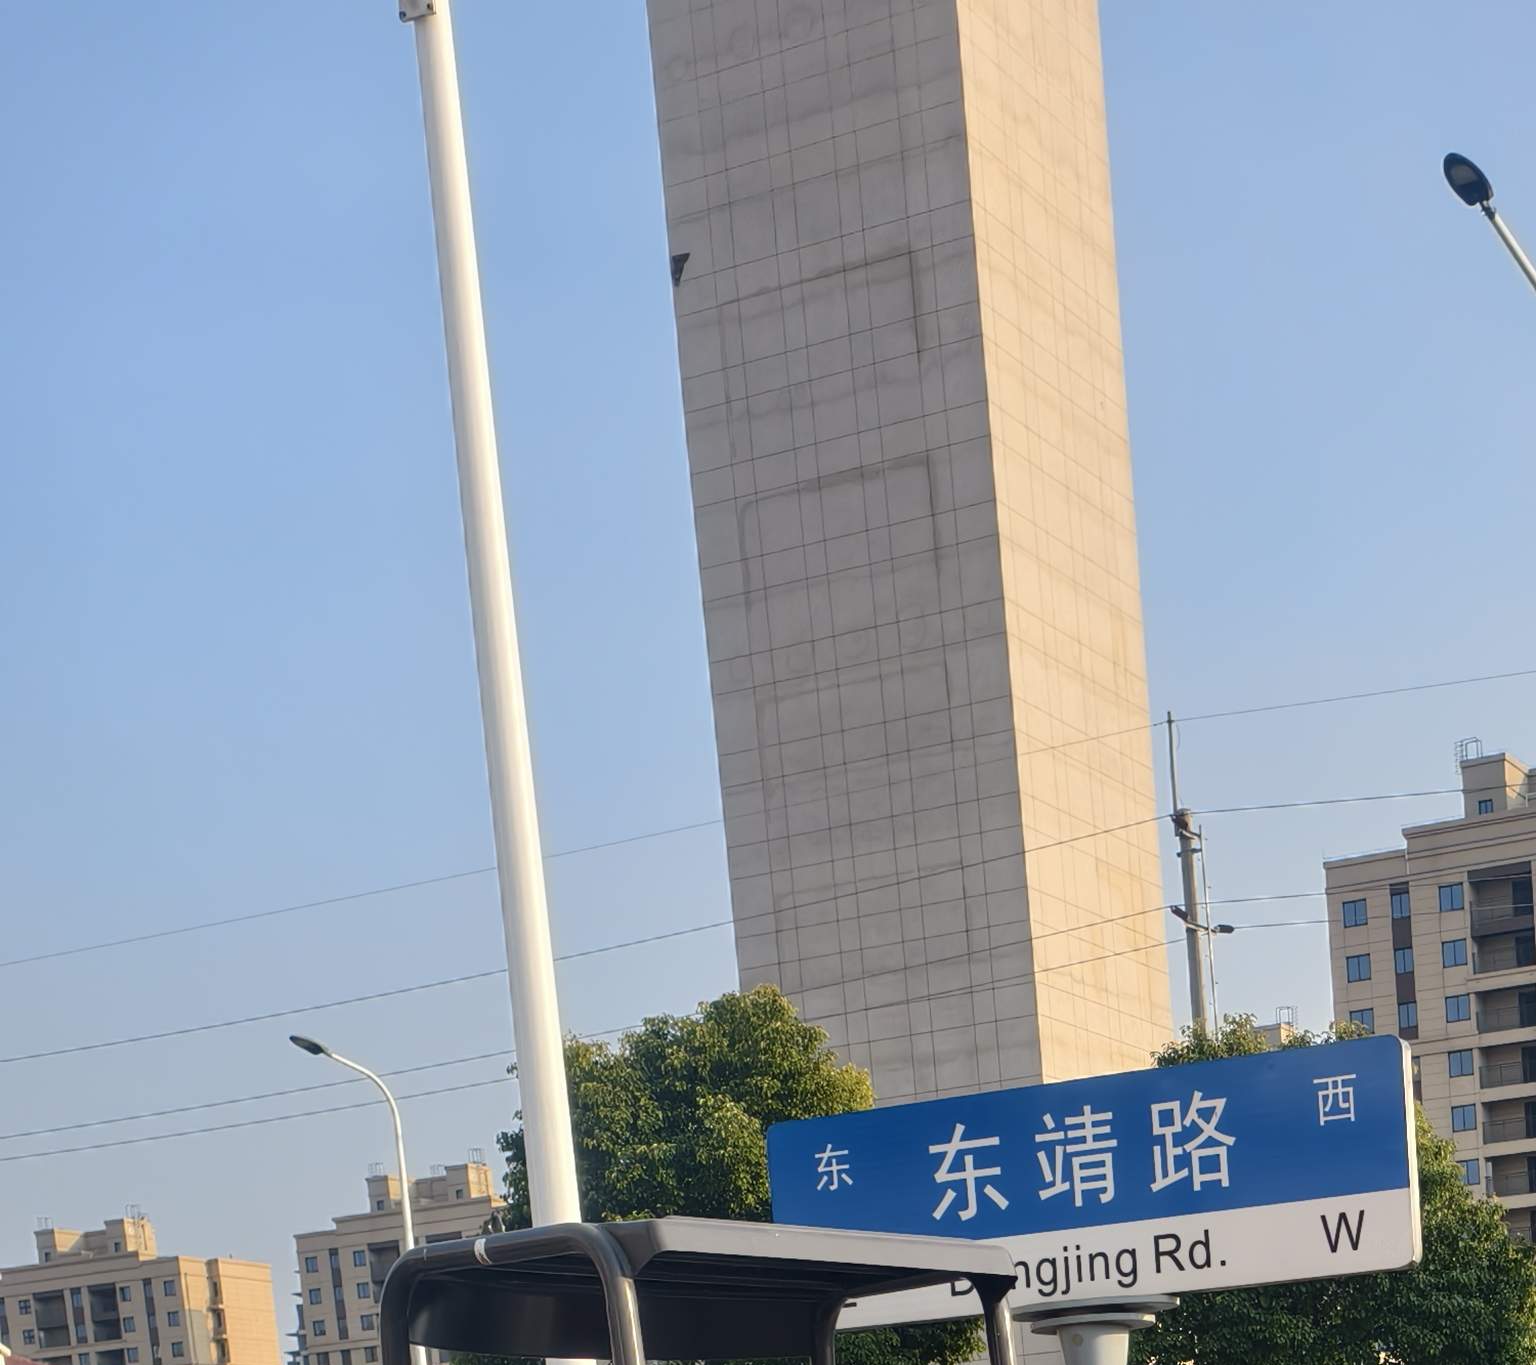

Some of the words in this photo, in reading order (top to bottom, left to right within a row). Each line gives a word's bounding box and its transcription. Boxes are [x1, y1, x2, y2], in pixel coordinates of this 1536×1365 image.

[815, 1143, 853, 1192] 东
[929, 1091, 1236, 1221] 东靖路
[1313, 1074, 1357, 1125] 西
[951, 1245, 1138, 1297] ngjing
[1154, 1229, 1227, 1273] Rd.
[1321, 1210, 1365, 1253] W
